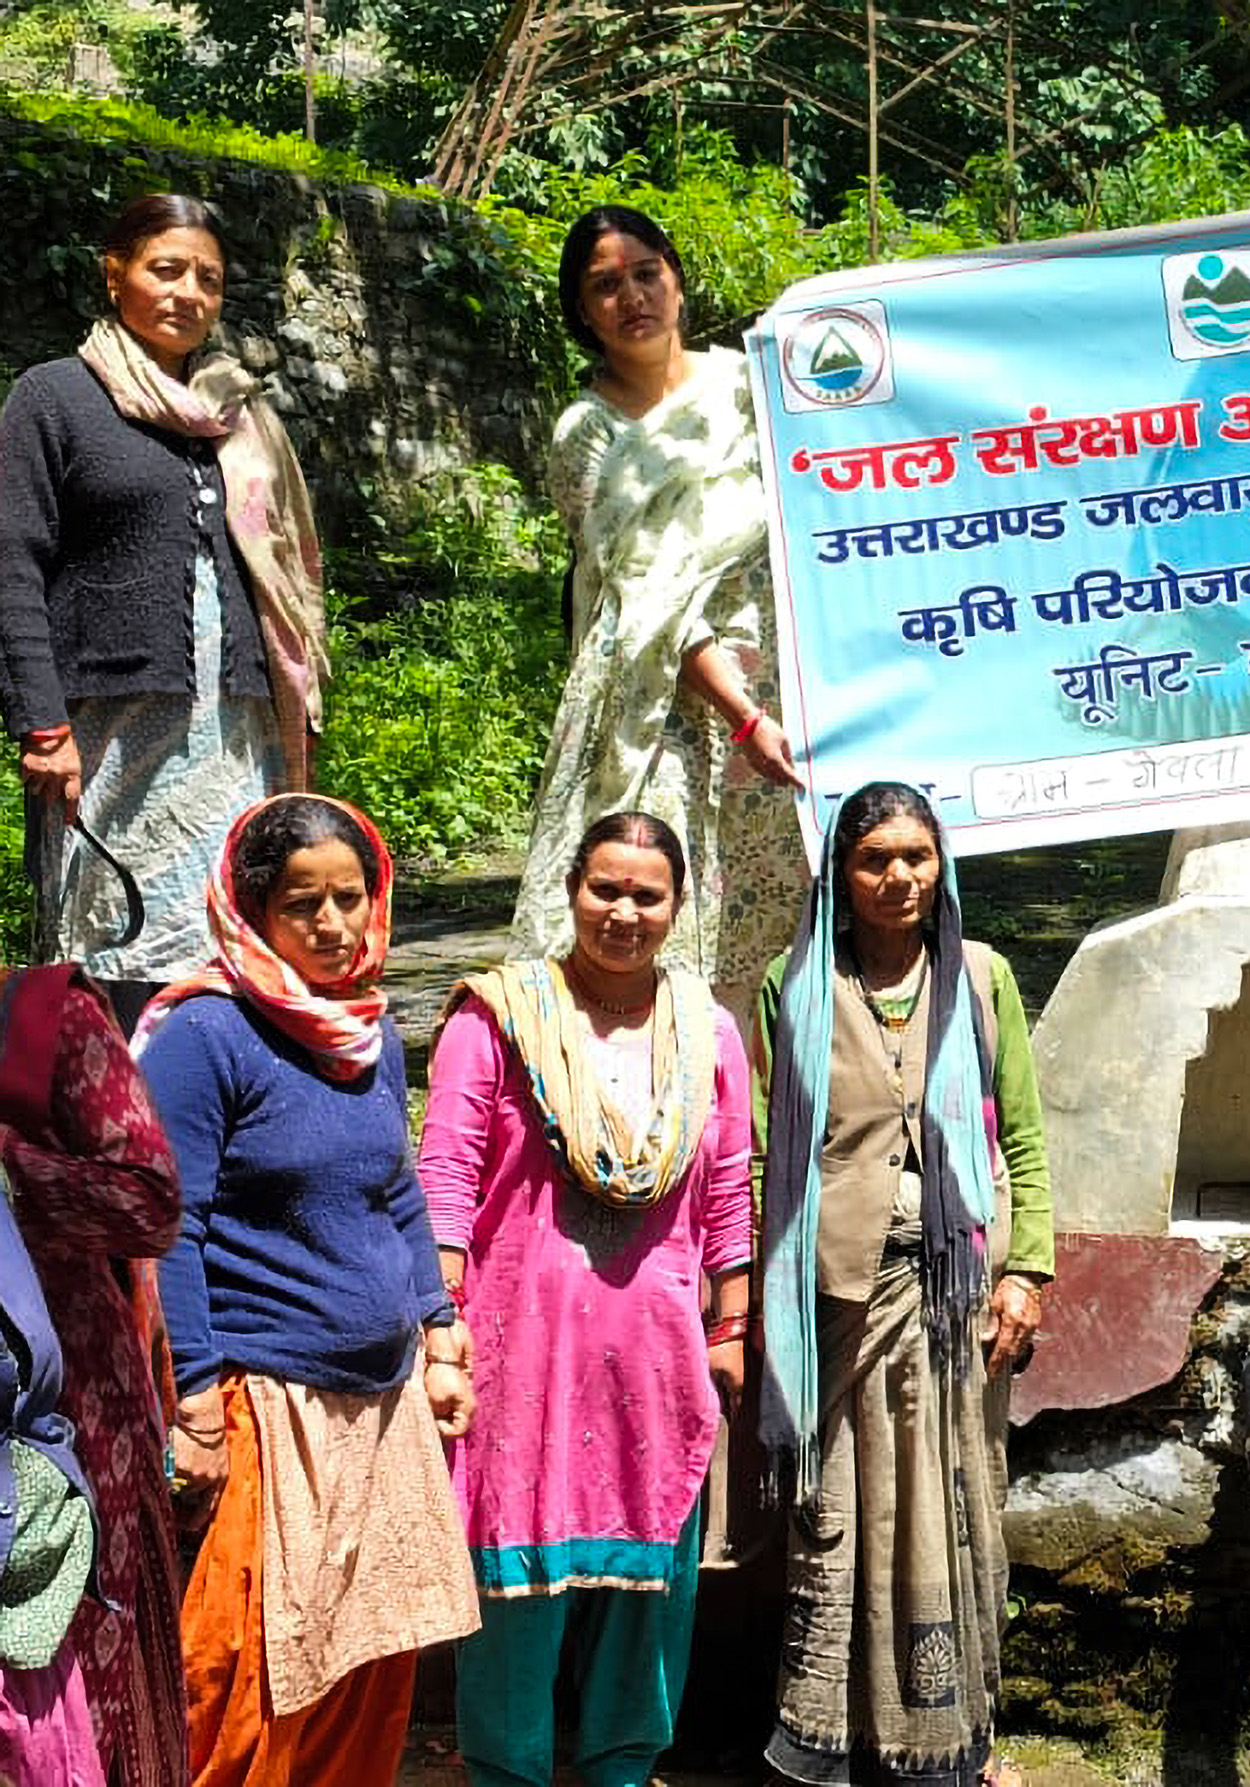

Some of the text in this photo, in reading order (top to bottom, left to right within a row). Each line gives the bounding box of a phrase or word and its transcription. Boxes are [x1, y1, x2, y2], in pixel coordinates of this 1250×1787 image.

[972, 403, 1201, 474] संरक्षण
[812, 500, 1067, 562] उत्तराखण्ड
[898, 585, 1018, 656] कृषि
